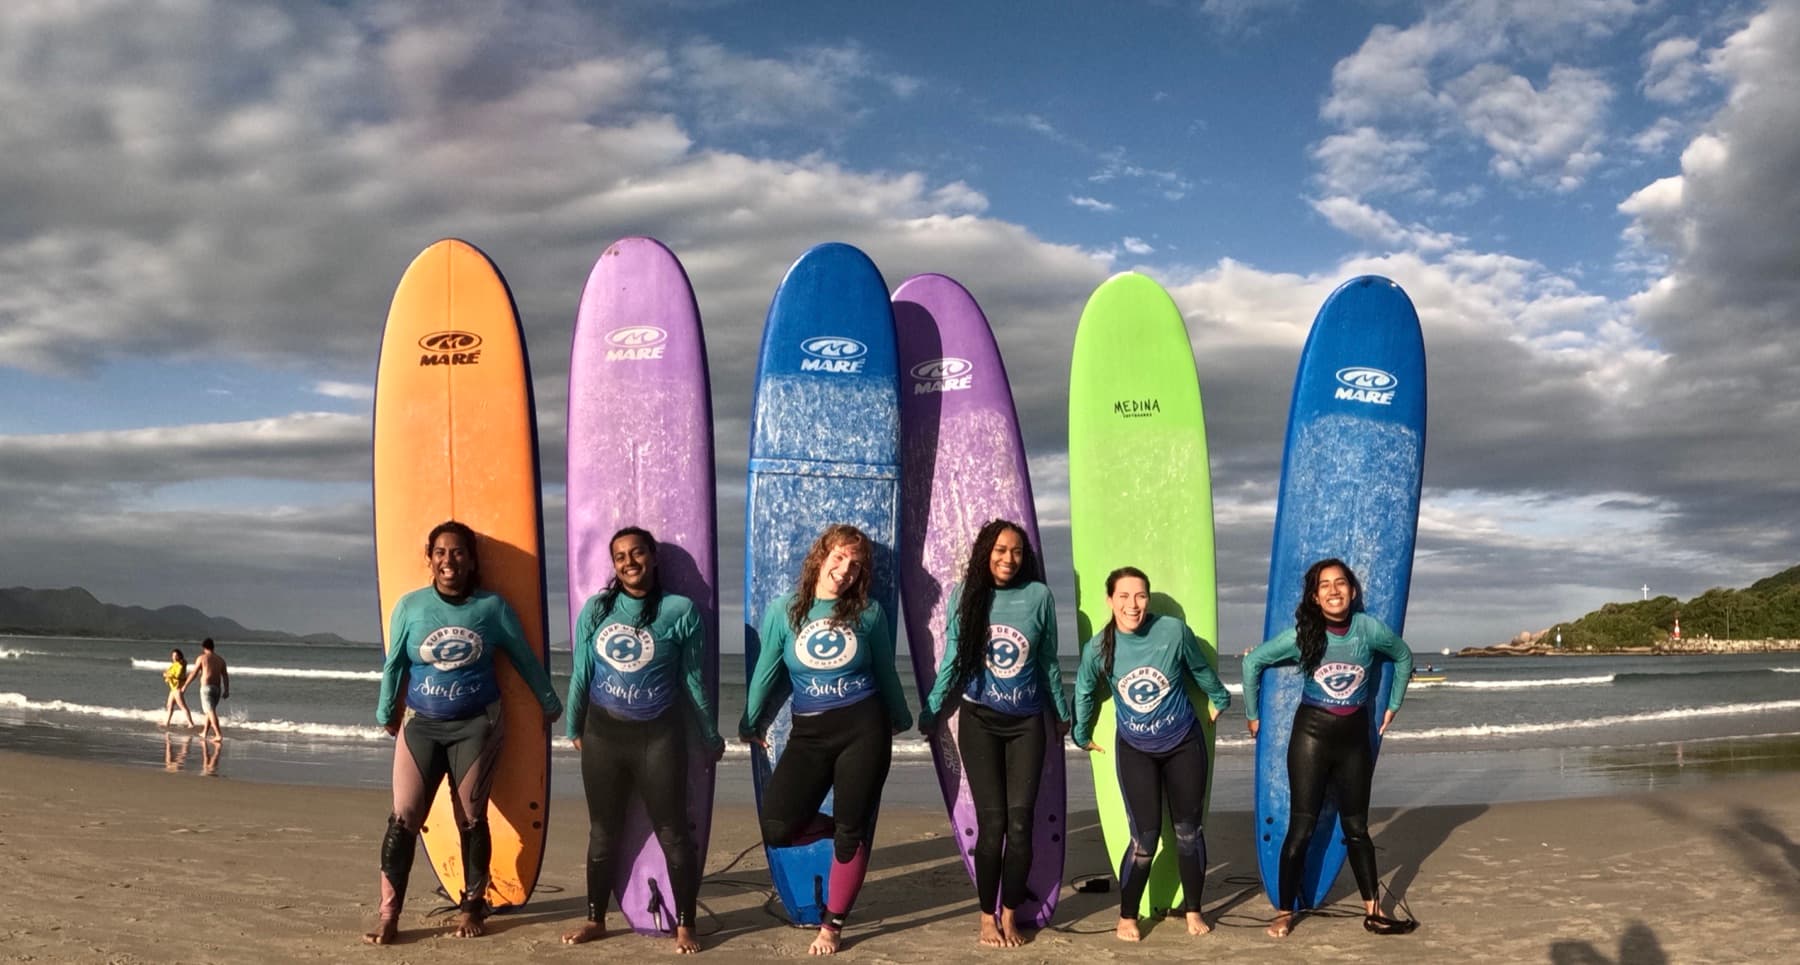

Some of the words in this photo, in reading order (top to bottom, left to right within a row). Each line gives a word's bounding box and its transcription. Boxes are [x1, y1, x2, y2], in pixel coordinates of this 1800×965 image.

[1114, 398, 1161, 415] MEDINA
[427, 629, 449, 647] SURF
[600, 625, 619, 641] SURF
[996, 626, 1009, 634] DE
